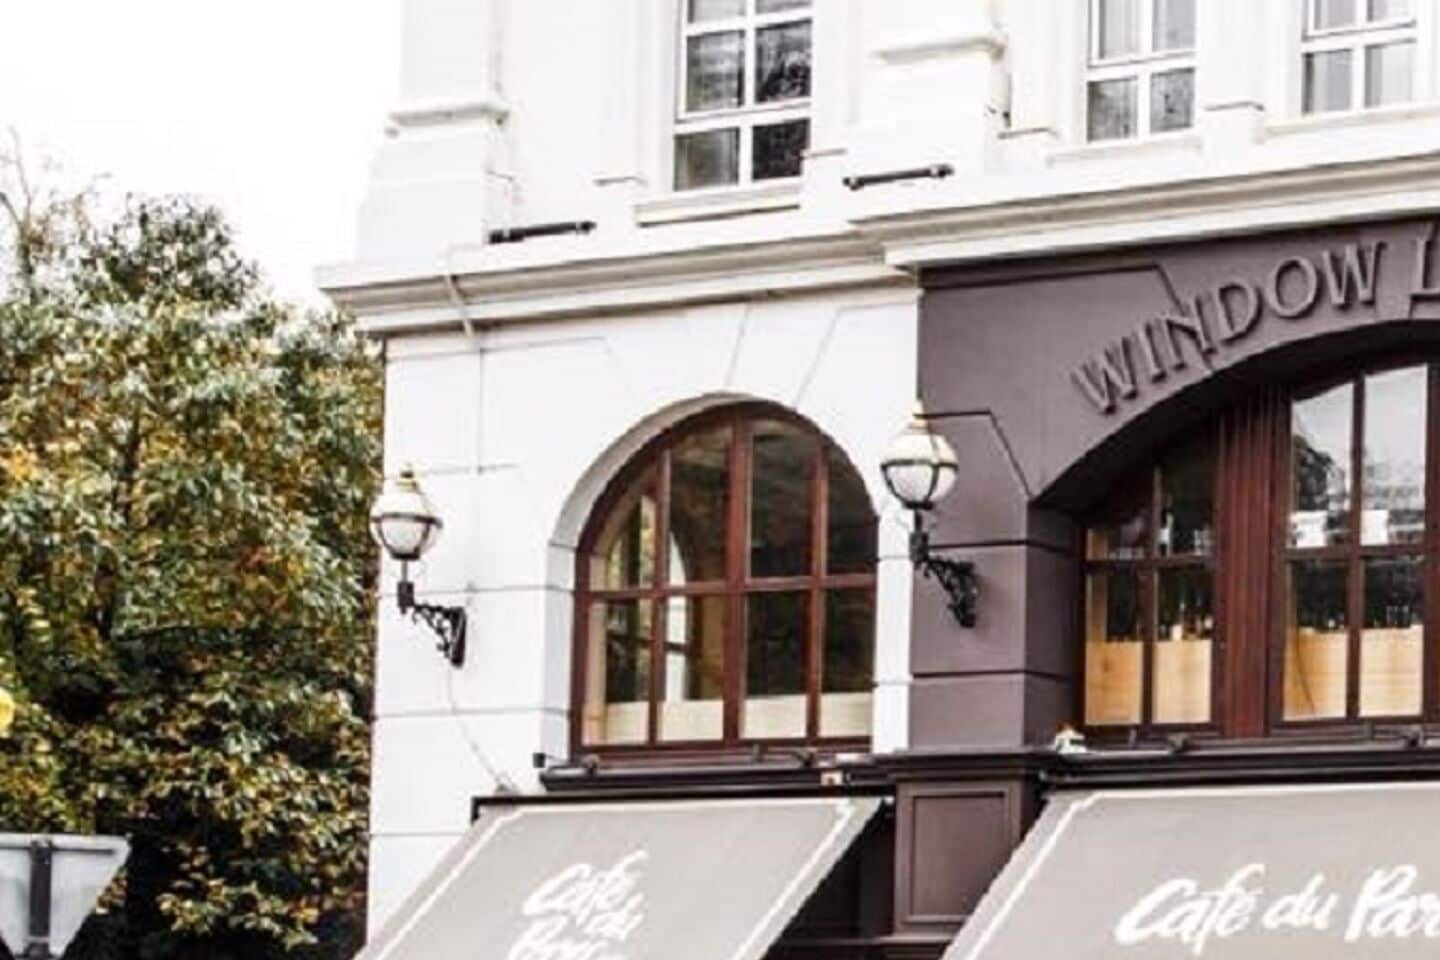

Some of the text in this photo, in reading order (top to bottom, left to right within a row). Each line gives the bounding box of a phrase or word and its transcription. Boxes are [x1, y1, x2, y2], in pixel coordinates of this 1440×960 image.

[1070, 238, 1386, 415] WINDOW
[1114, 863, 1266, 957] Café
[1262, 872, 1340, 931] du
